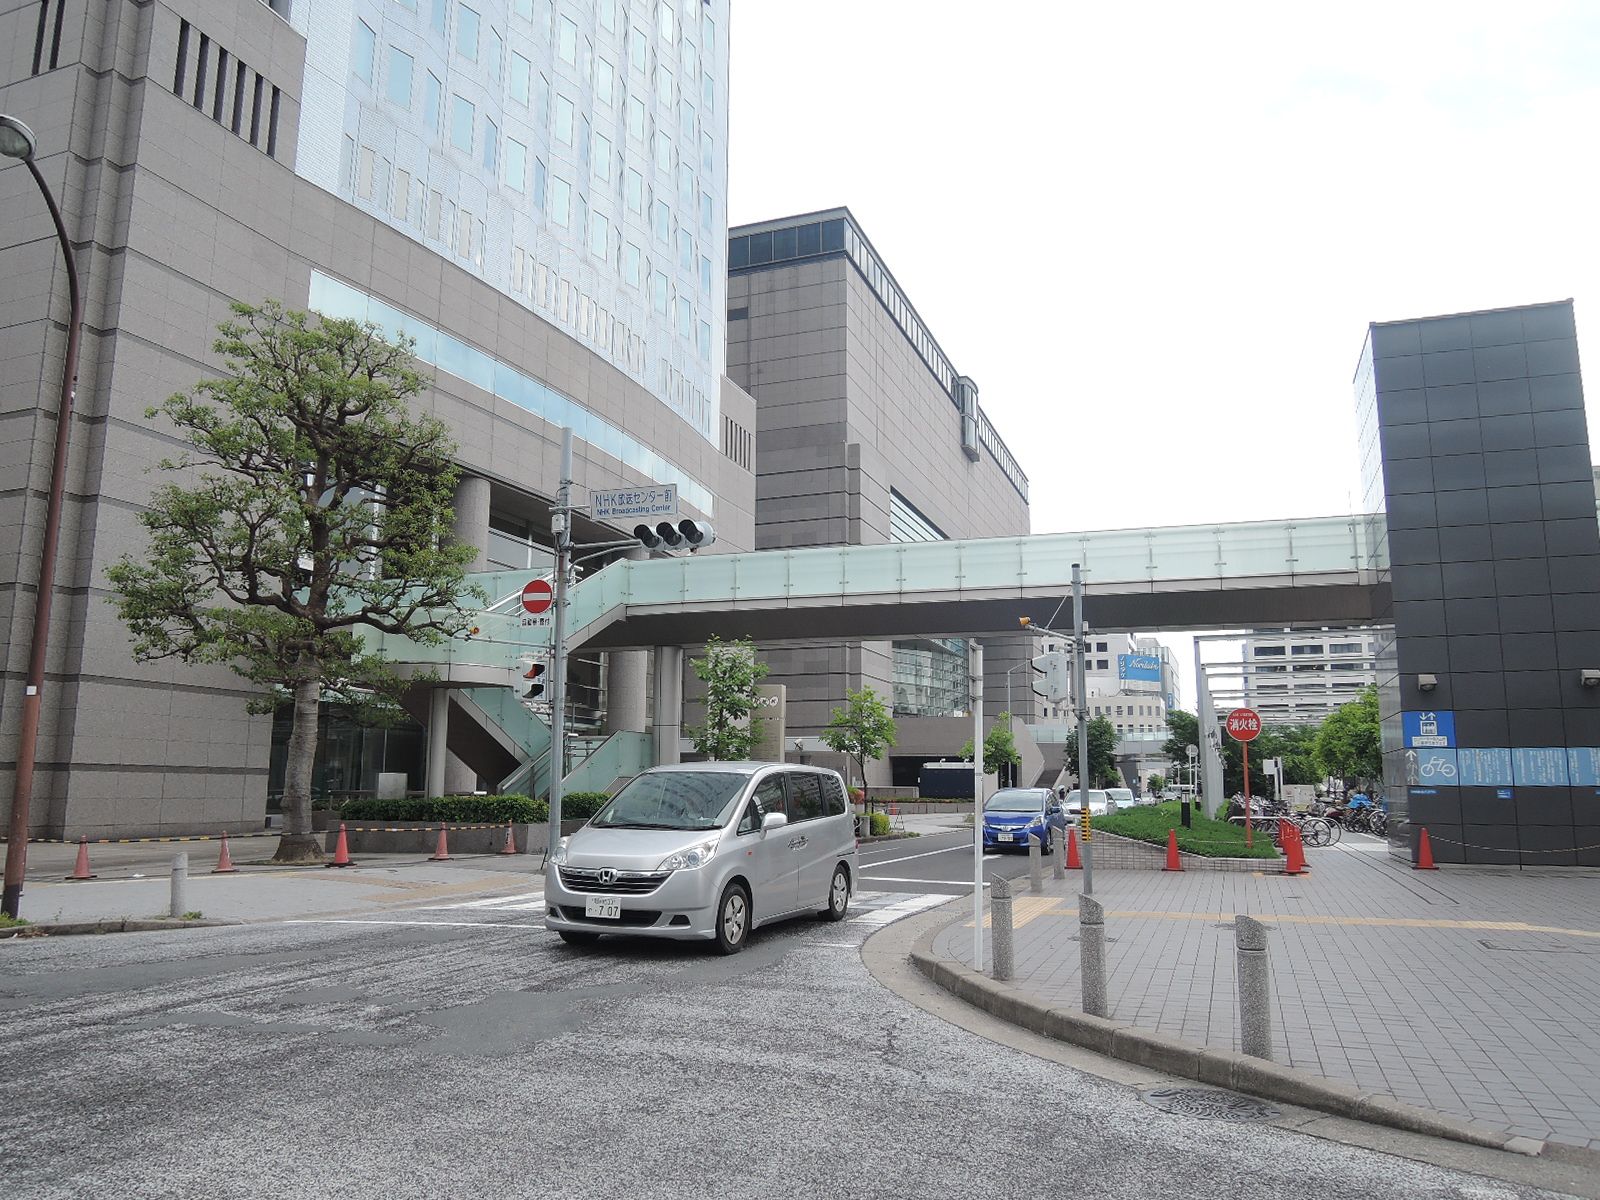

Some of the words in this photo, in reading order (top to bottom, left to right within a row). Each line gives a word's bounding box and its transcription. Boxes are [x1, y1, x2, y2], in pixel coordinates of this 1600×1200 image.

[595, 489, 672, 507] NHK放送センター前
[597, 508, 610, 516] NHK
[612, 505, 650, 515] Broadcasting
[652, 504, 671, 513] Center
[1229, 718, 1259, 731] 消火栓
